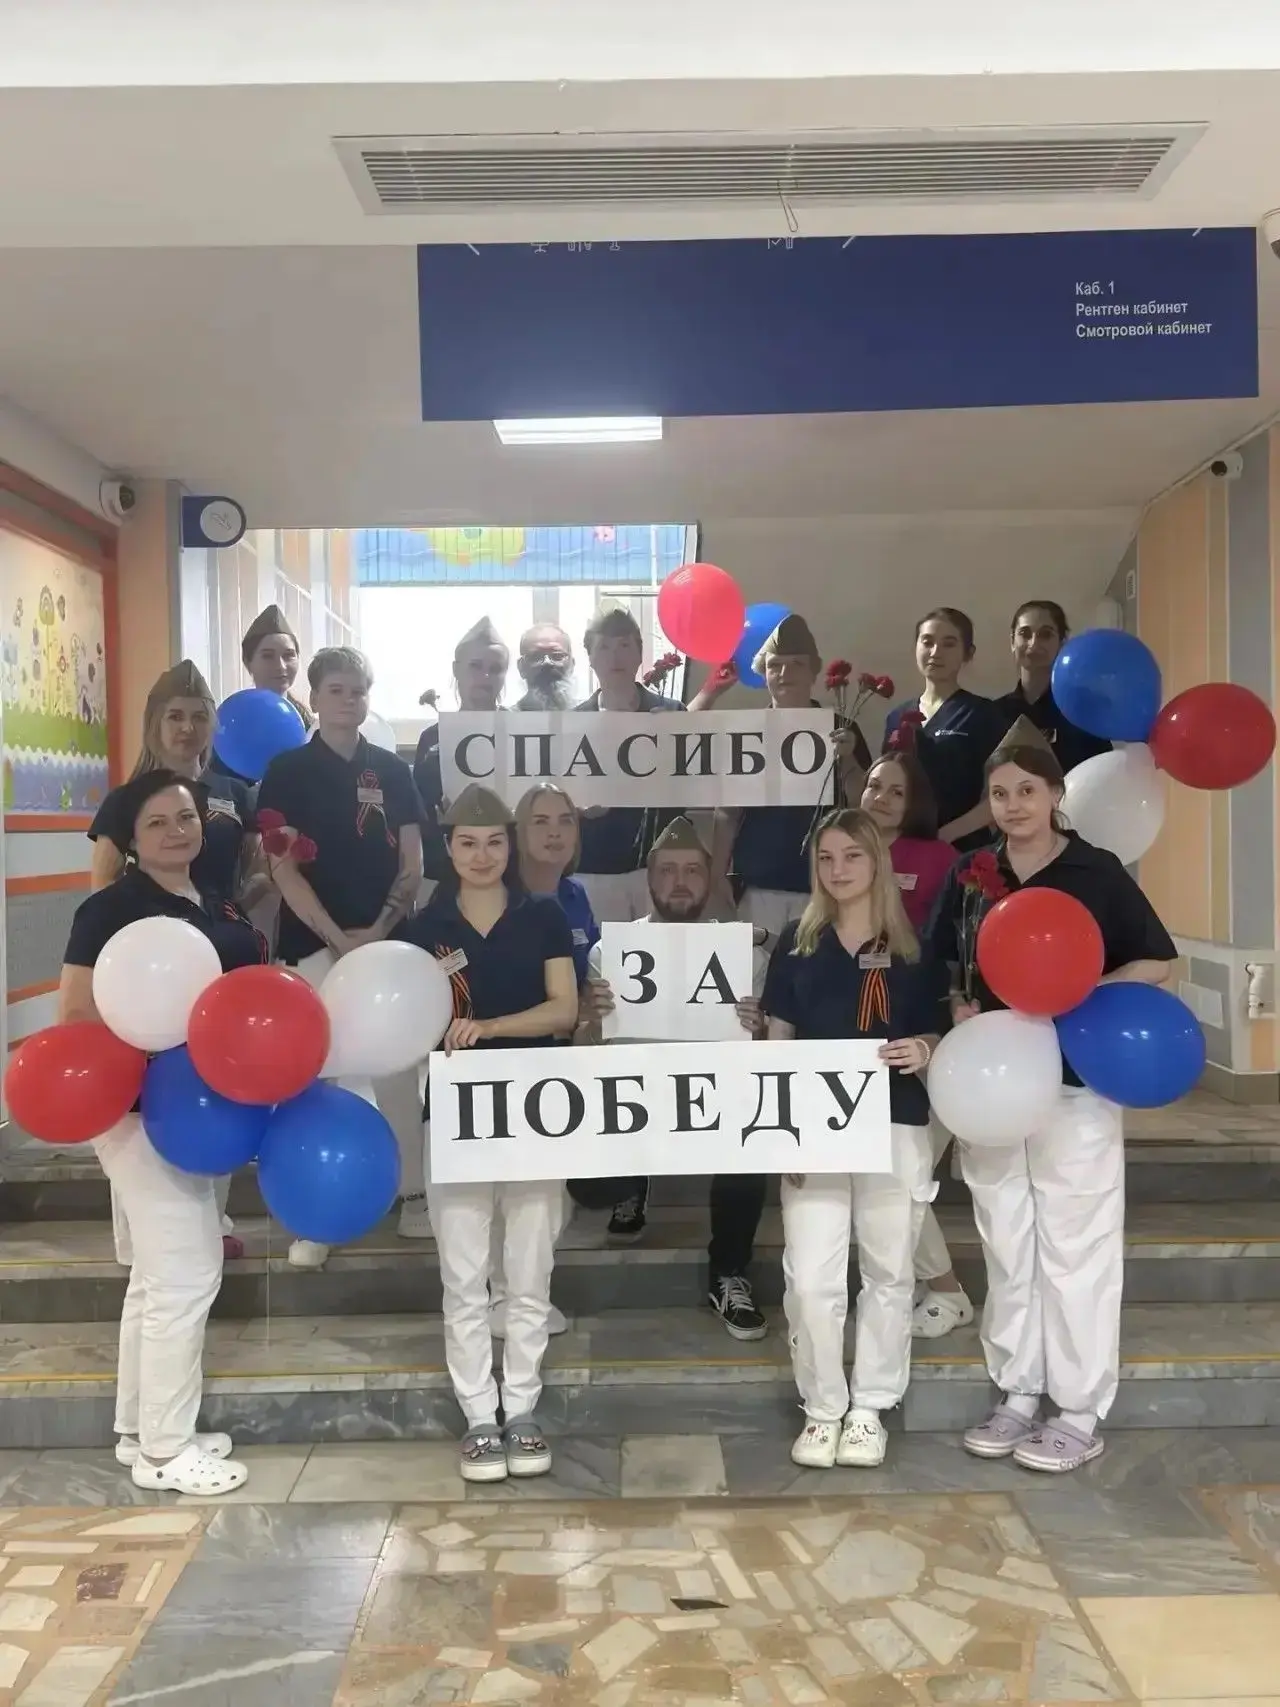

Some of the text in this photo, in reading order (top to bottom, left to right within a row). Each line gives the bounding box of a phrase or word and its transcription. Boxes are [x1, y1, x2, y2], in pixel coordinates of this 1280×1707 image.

[1075, 281, 1115, 295] Каб. 1
[1075, 300, 1188, 316] Рентген кабинет
[1075, 320, 1212, 339] Смотровой кабинет
[453, 730, 828, 779] СПАСИБО
[450, 1070, 877, 1147] ПОБЕДУ
